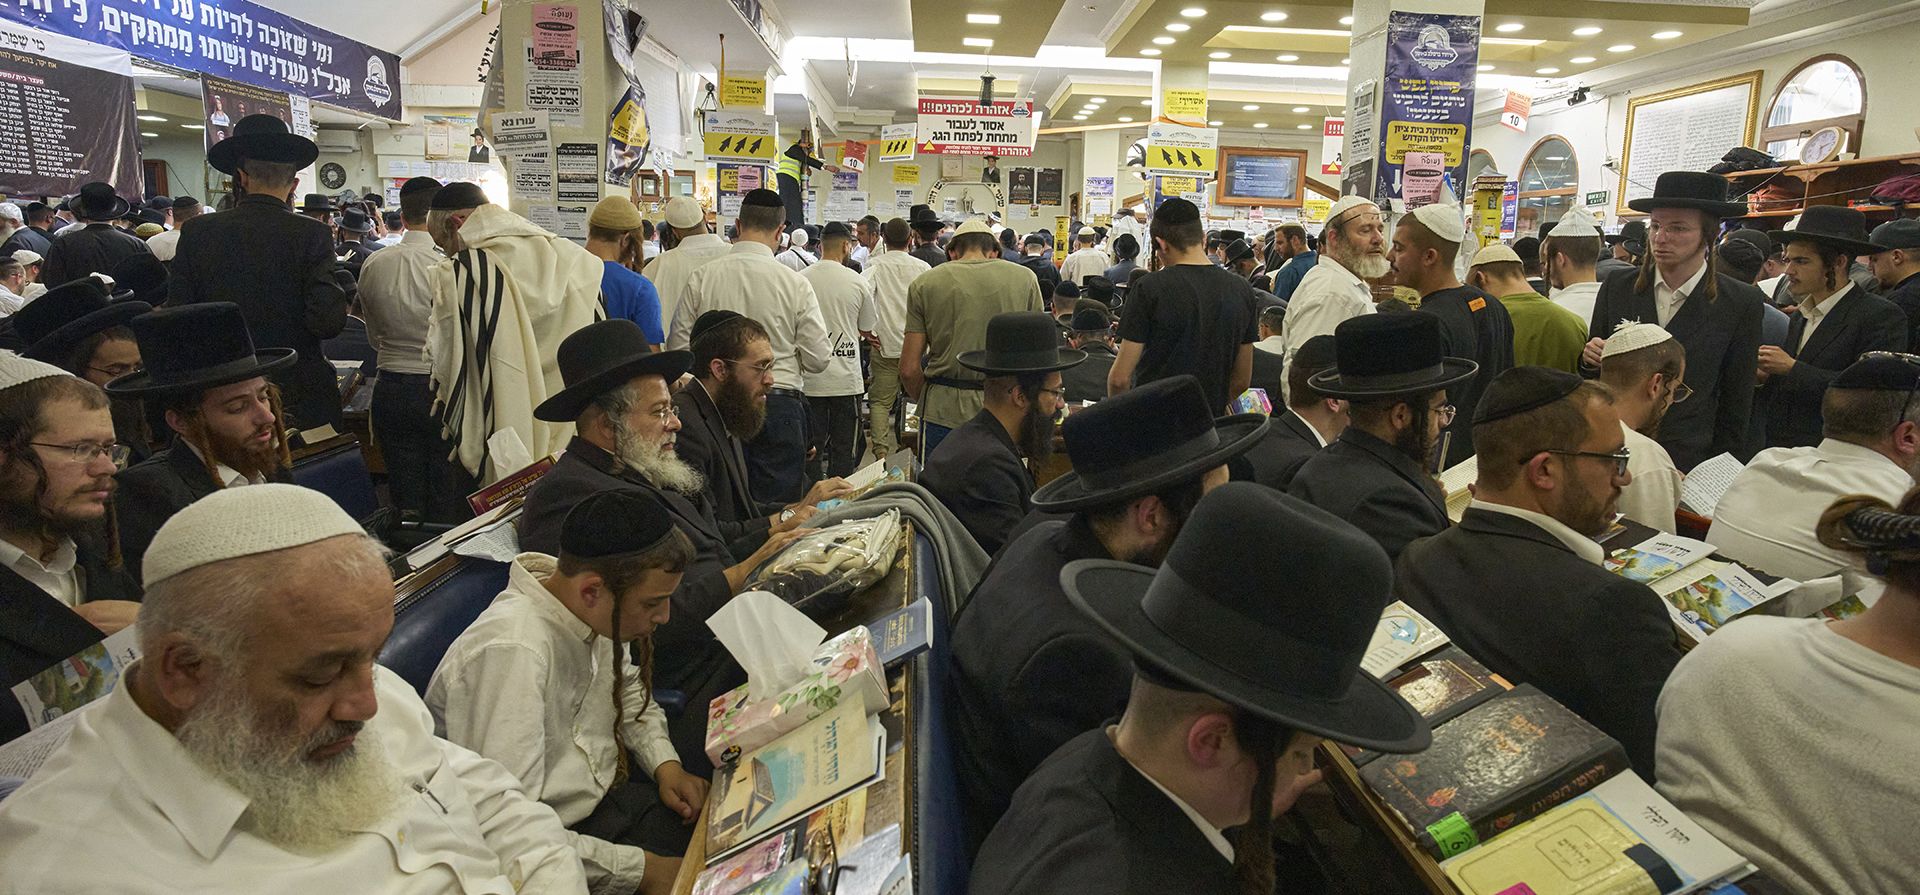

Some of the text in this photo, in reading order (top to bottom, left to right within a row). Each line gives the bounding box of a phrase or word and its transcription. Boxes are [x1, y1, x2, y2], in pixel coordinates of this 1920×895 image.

[922, 102, 1009, 115] אזהרה לכהנים!!!
[501, 118, 513, 126] נא
[1510, 114, 1520, 126] 10
[945, 119, 1004, 131] אסור לעבור
[1394, 125, 1409, 133] ציון
[1426, 127, 1458, 136] להחזקת
[932, 131, 1018, 143] מתחת לפתח הגג
[1402, 134, 1428, 143] הקדוש
[997, 147, 1029, 156] אזהרה!
[849, 158, 858, 168] 10
